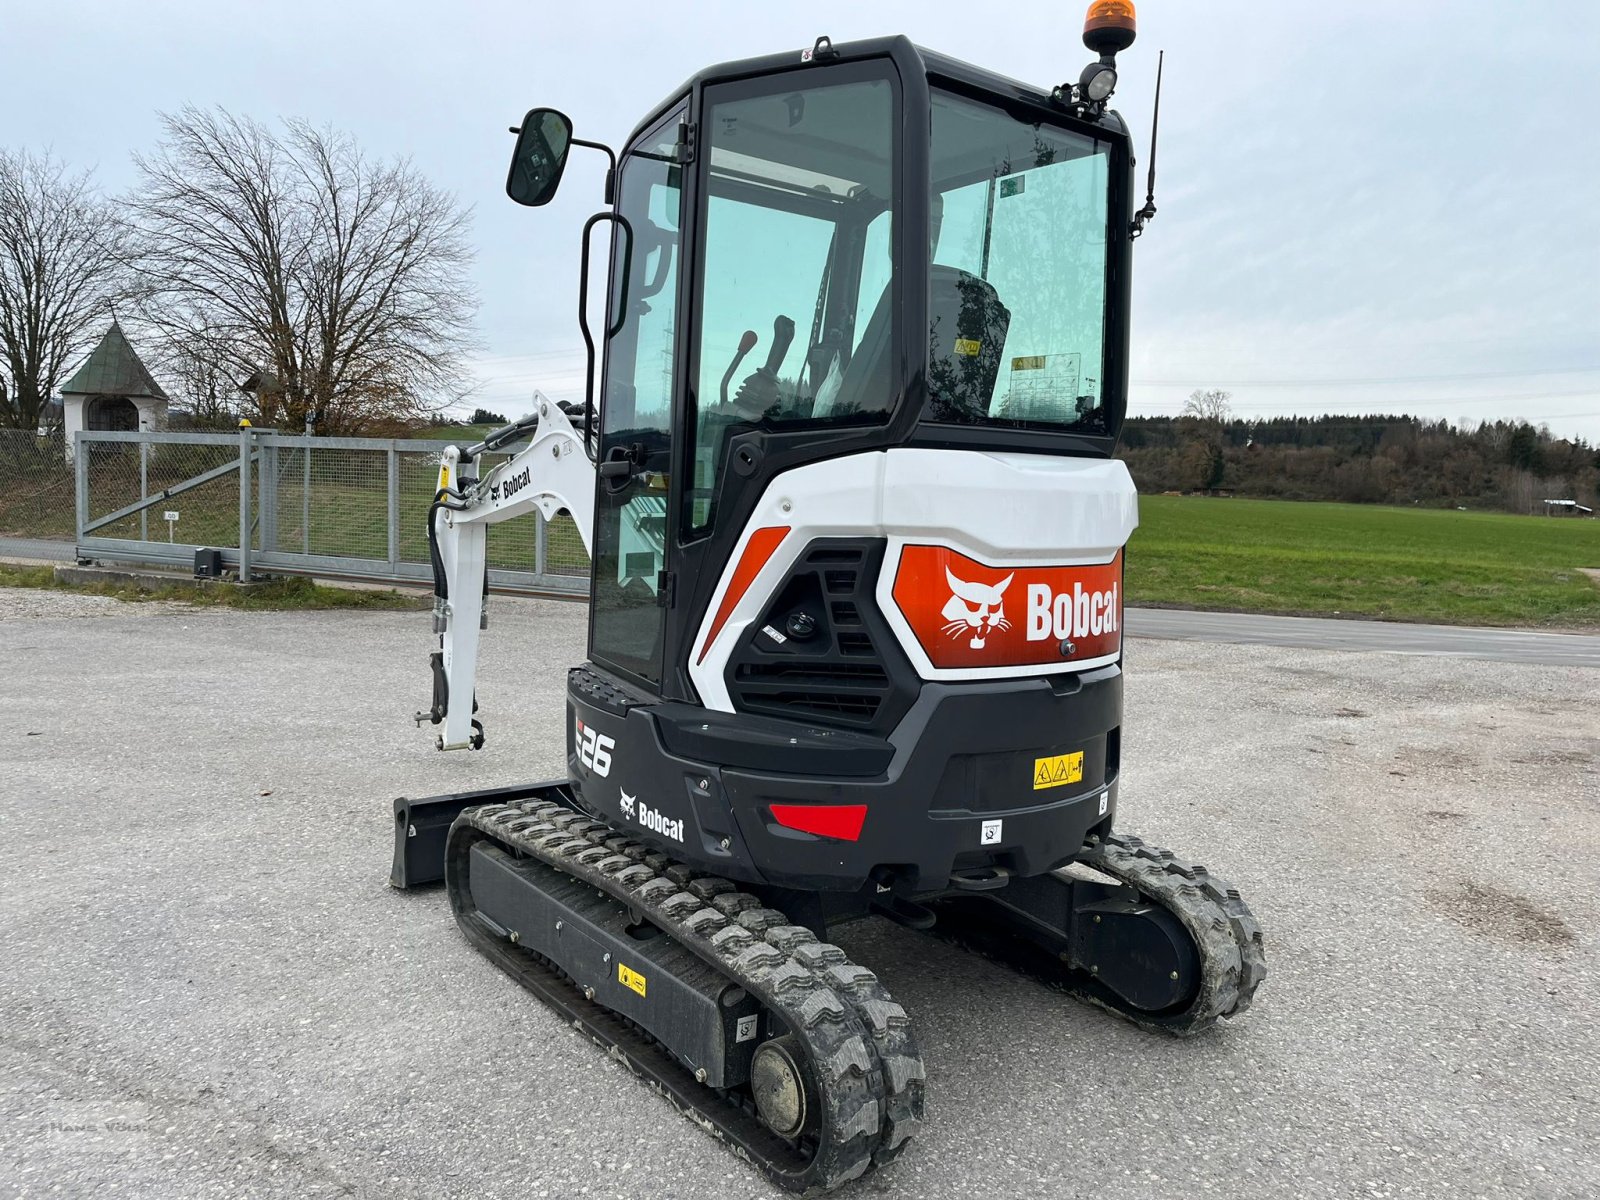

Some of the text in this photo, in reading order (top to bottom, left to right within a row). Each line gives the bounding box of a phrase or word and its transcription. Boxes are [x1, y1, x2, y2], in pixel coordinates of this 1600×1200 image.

[503, 466, 531, 500] Bobcat
[1026, 581, 1118, 642] Bobcat
[639, 802, 684, 843] Bobcat
